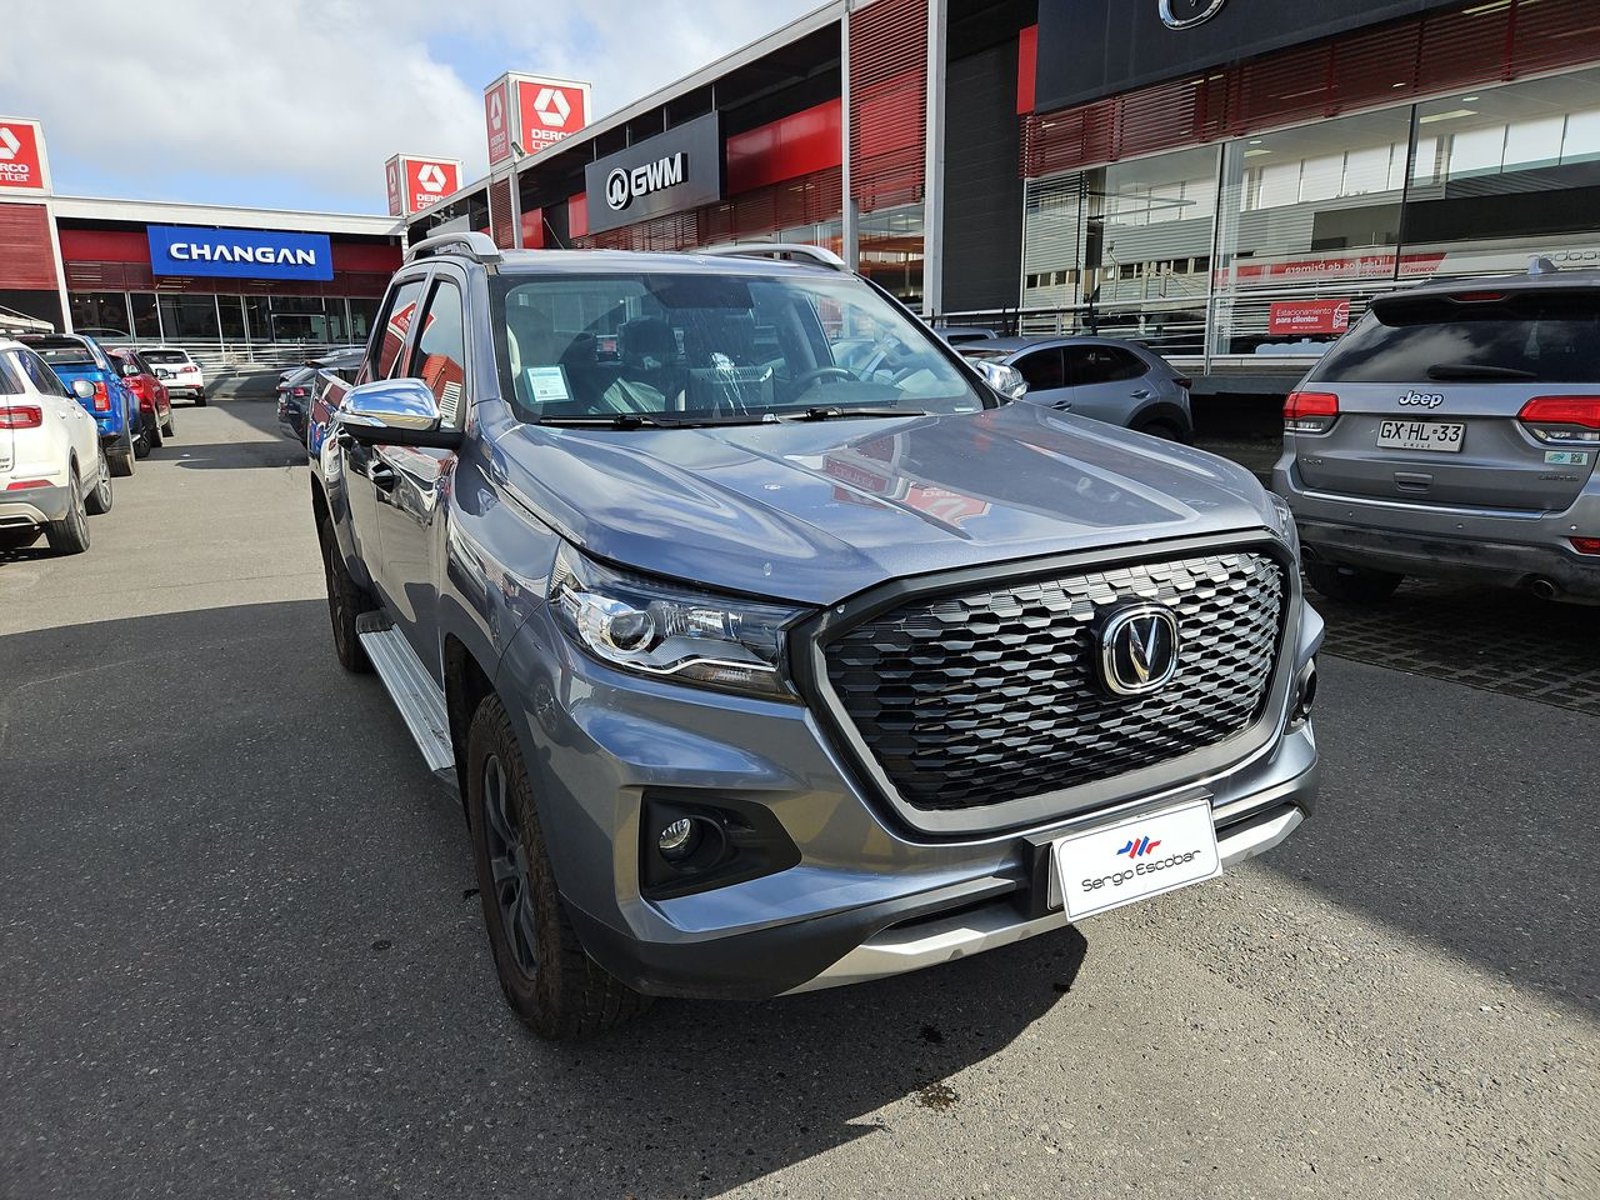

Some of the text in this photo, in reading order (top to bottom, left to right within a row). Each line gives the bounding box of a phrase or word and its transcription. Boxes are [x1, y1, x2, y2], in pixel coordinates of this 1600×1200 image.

[531, 129, 573, 141] DERC
[0, 163, 30, 173] RCO
[0, 171, 30, 182] nter
[630, 152, 684, 197] GWM
[169, 243, 317, 266] CHANGAN
[1276, 307, 1332, 316] Estacionamiento
[1275, 316, 1319, 325] para clientes
[1399, 390, 1443, 409] Jeep
[1135, 849, 1202, 876] Escobar
